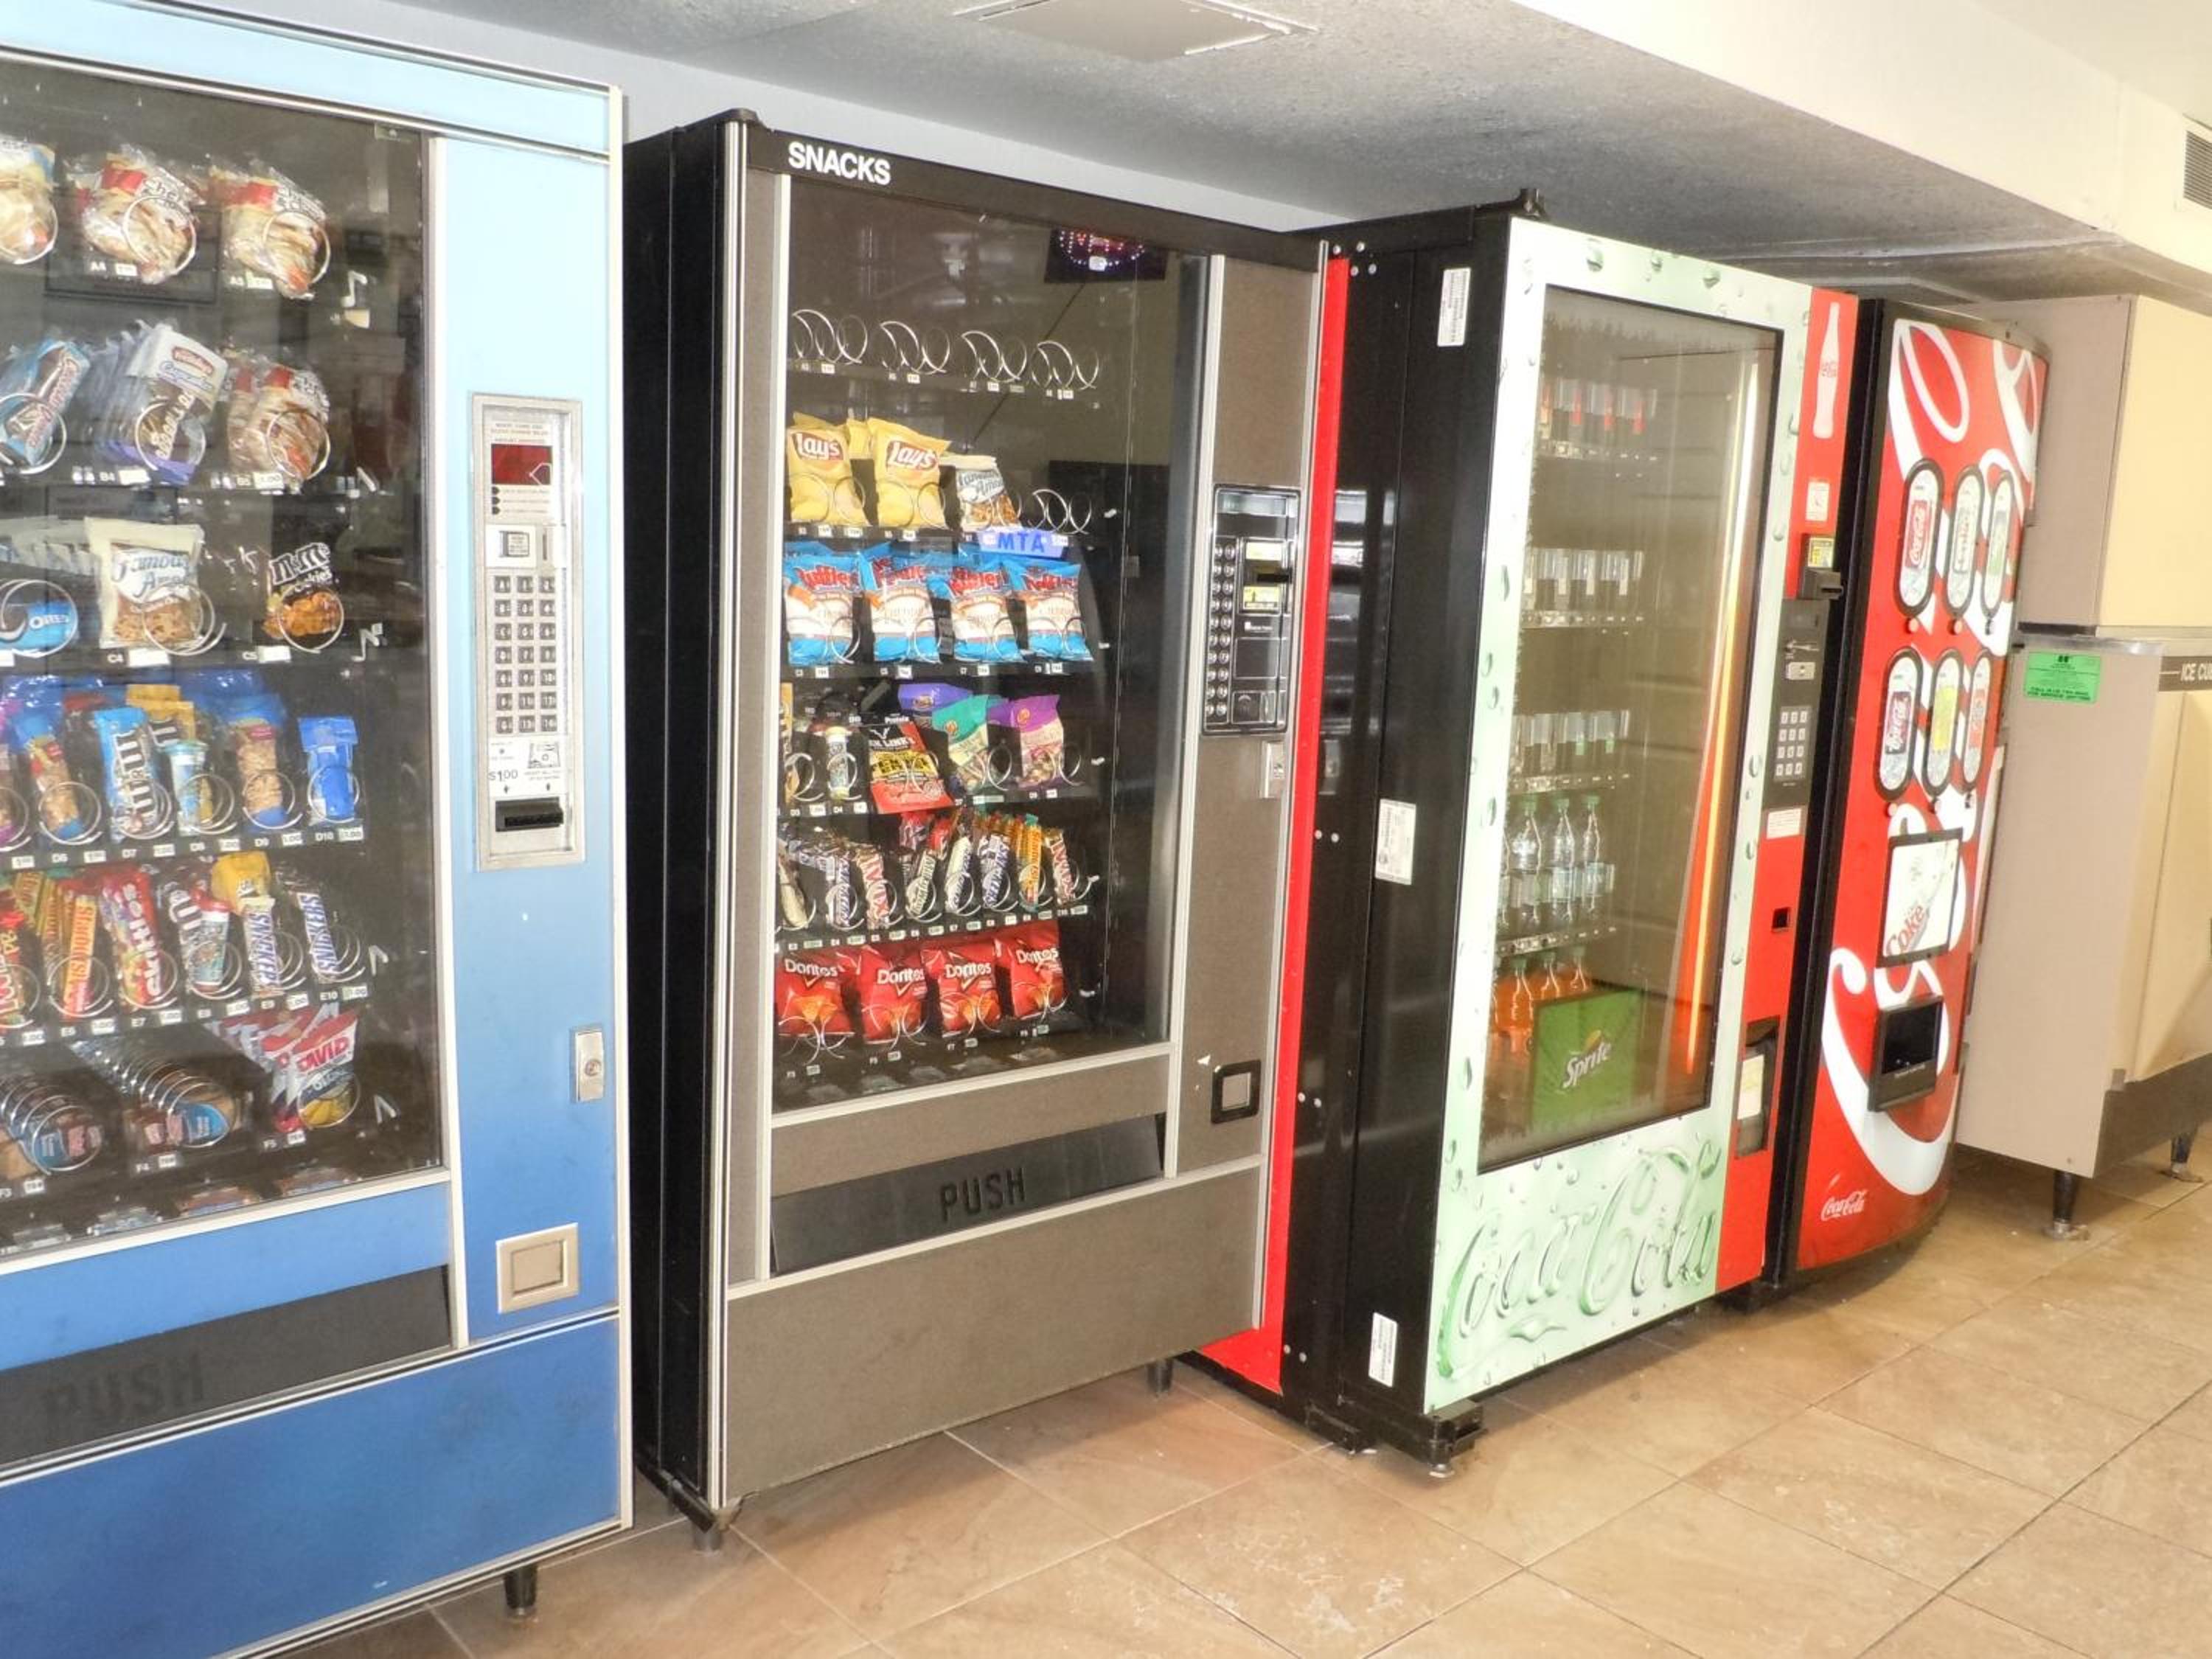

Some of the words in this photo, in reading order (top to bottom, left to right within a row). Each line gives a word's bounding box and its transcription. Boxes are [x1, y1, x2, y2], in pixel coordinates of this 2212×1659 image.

[788, 142, 891, 185] SNACKS
[796, 433, 840, 459] Lay's
[888, 442, 936, 468] Lay's
[998, 532, 1044, 552] MTA
[2180, 663, 2196, 681] ICE
[1886, 905, 1924, 956] Coke
[1016, 947, 1059, 964] Doritos
[785, 959, 838, 977] Doritos
[877, 968, 925, 984] Doritos
[945, 963, 992, 978] Doritos
[1562, 1041, 1611, 1088] Sprite
[940, 1168, 1026, 1222] PUSH
